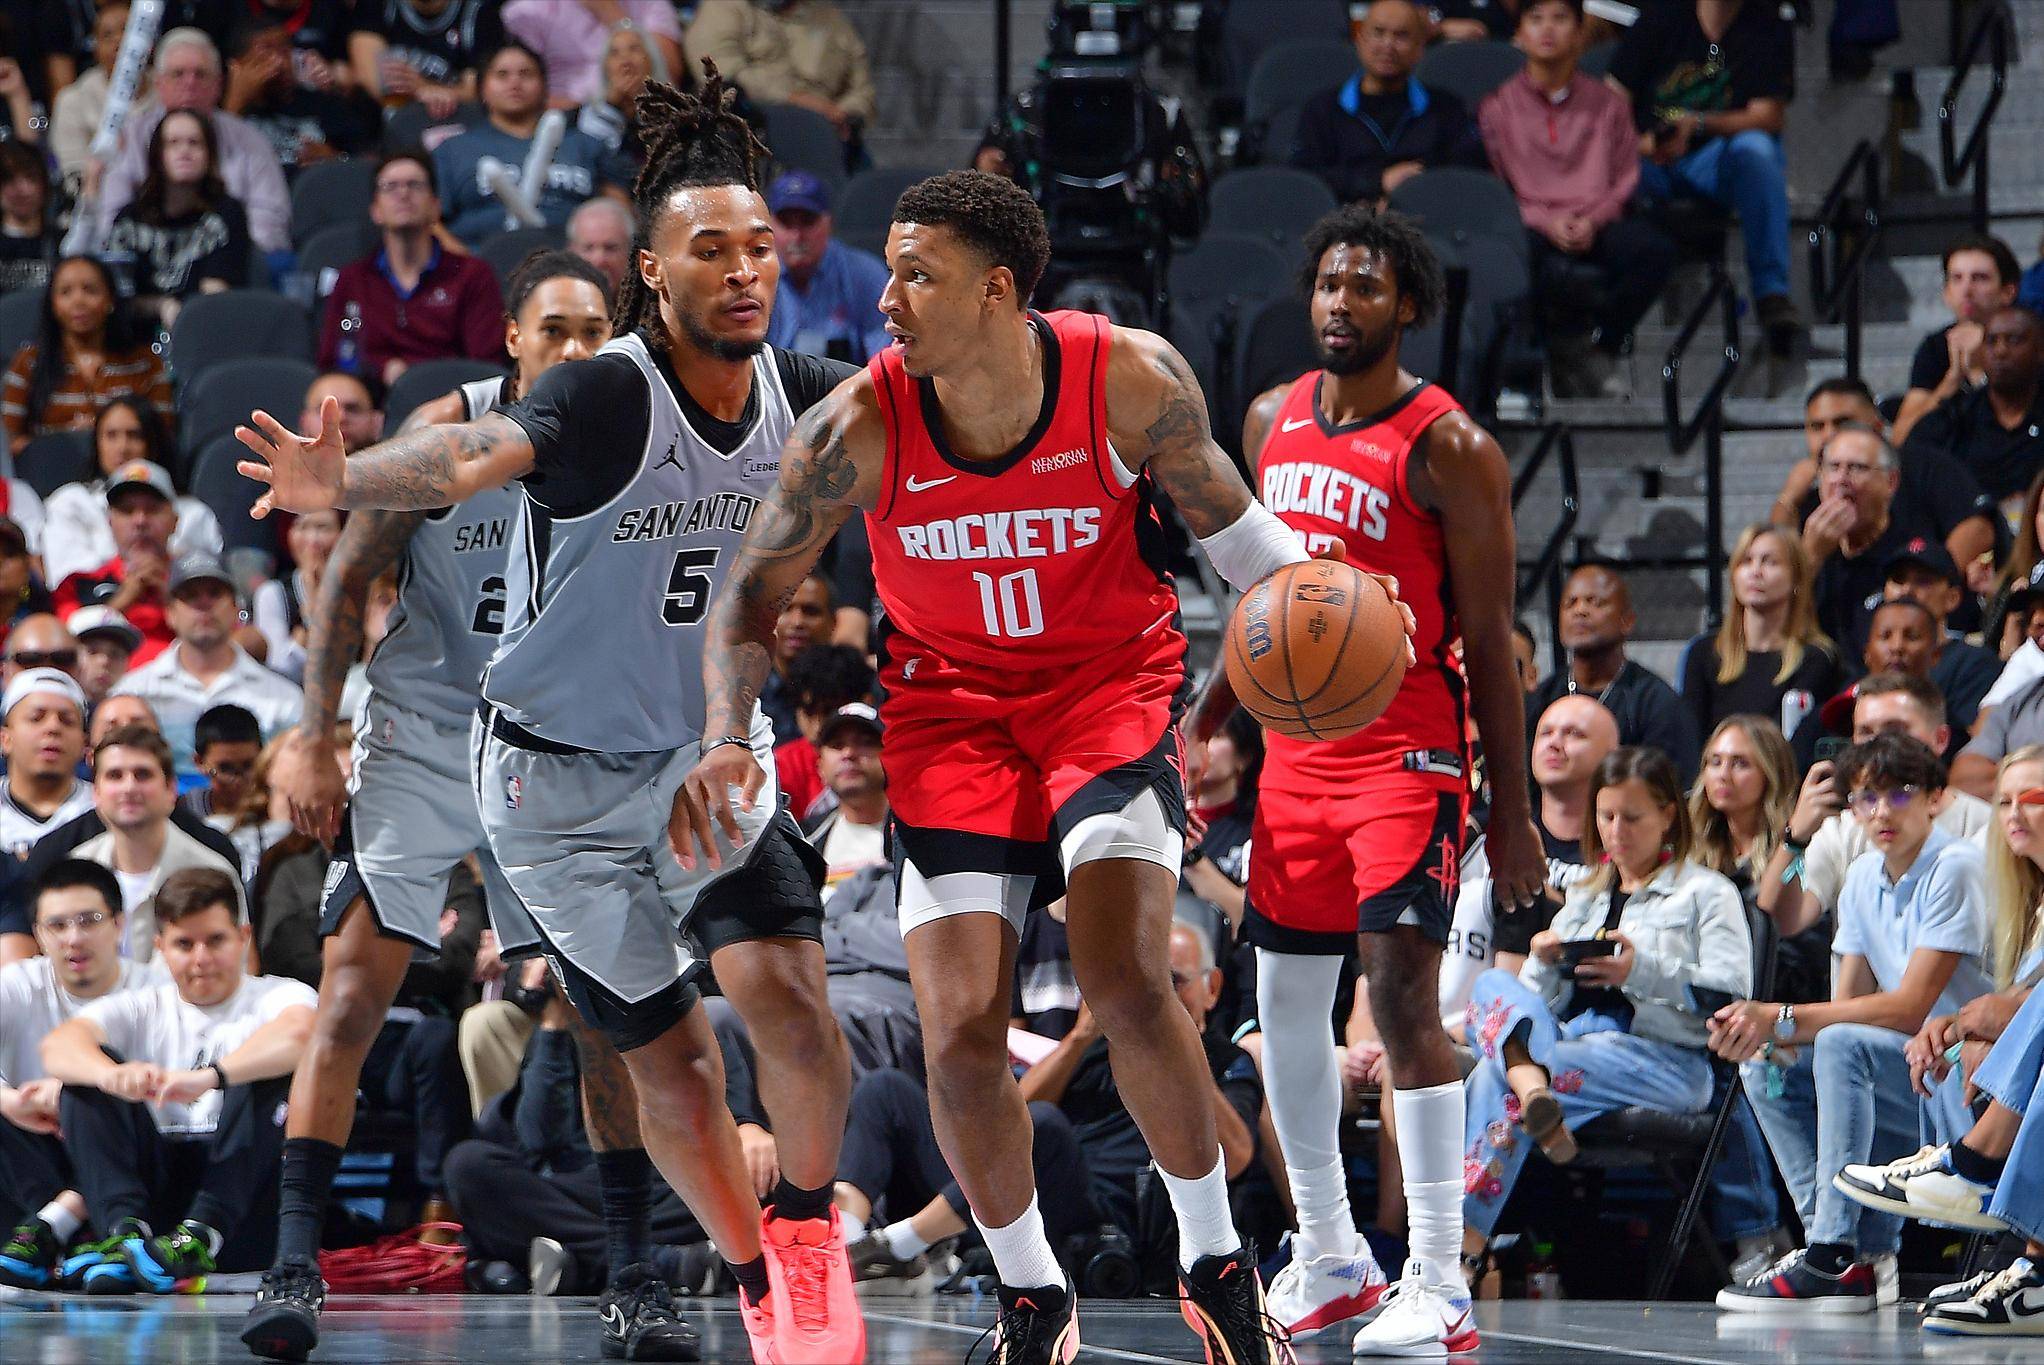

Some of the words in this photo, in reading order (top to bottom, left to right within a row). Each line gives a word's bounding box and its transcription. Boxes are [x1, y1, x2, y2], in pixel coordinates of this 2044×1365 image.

[1031, 448, 1088, 467] MEMORIAL
[1032, 454, 1088, 475] HERMANN
[612, 501, 687, 543] SAN
[1263, 461, 1390, 542] ROCKETS
[453, 517, 509, 554] SAN
[896, 507, 1101, 560] ROCKETS
[660, 547, 722, 627] 5
[972, 567, 1045, 638] 10
